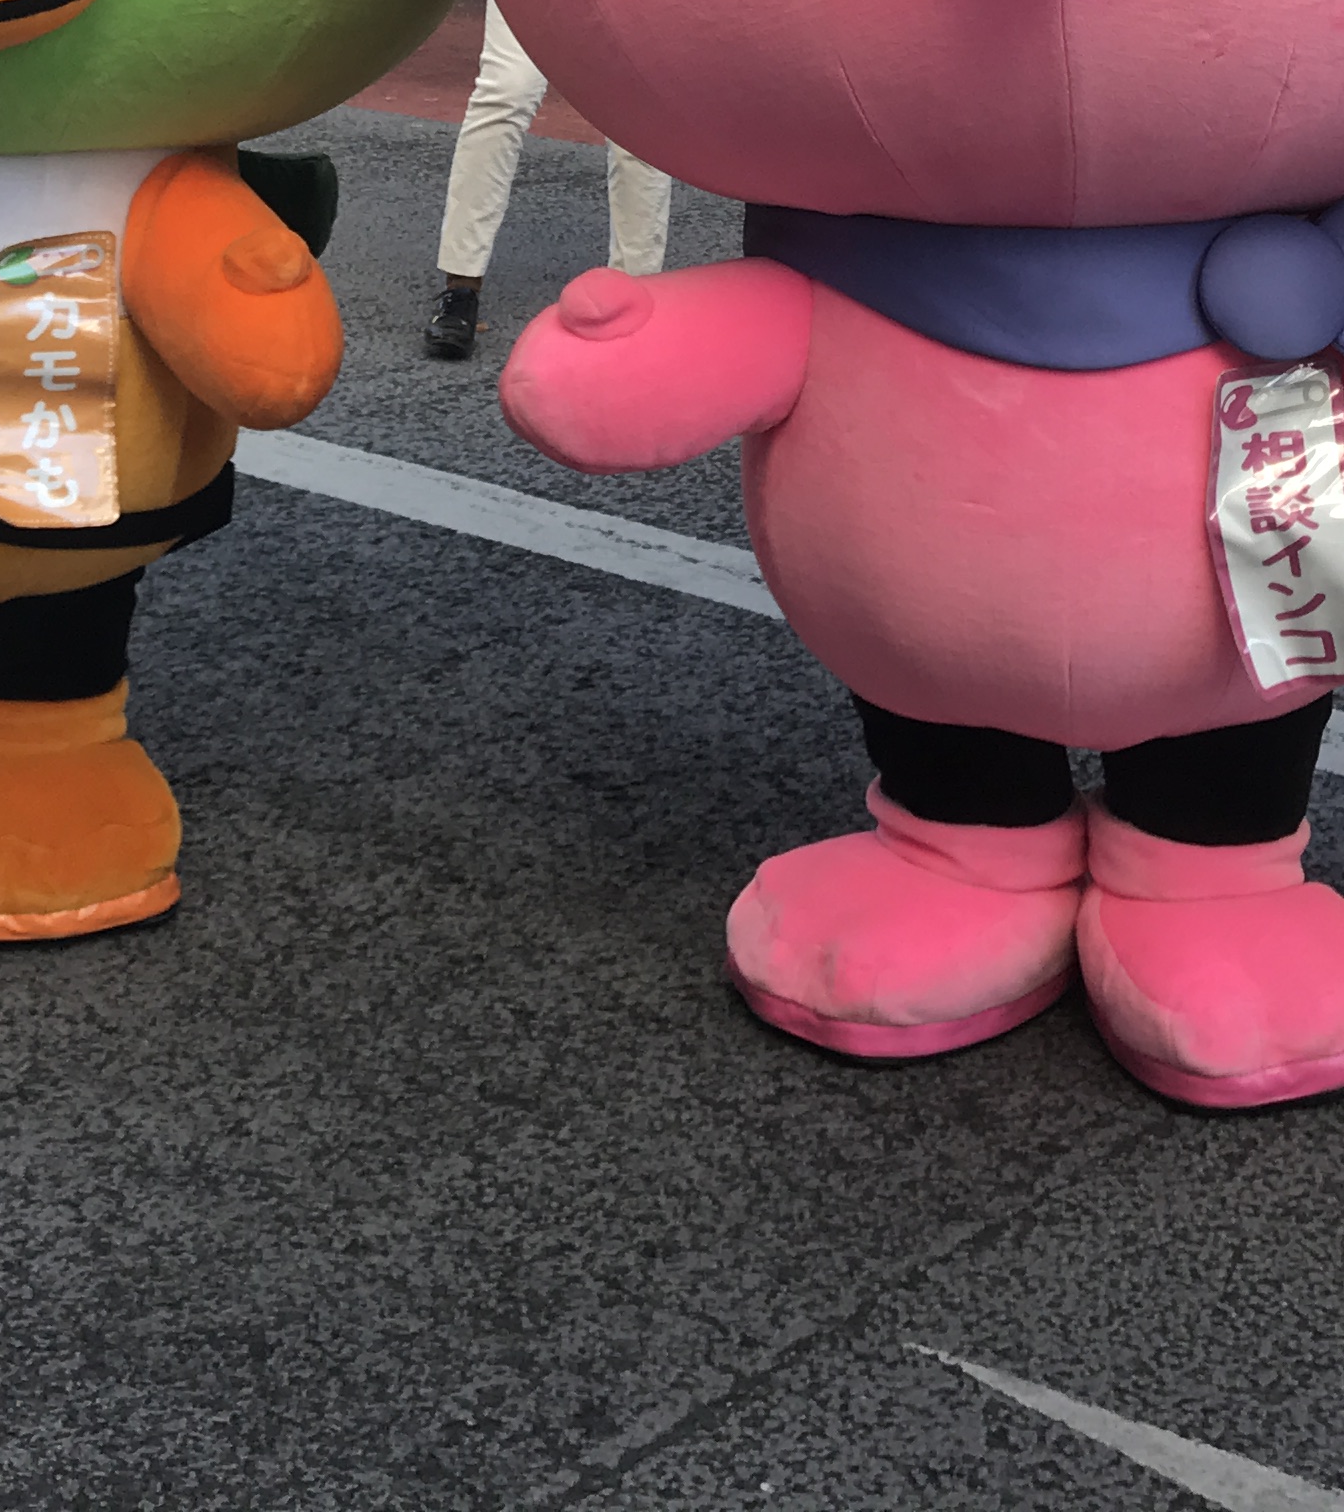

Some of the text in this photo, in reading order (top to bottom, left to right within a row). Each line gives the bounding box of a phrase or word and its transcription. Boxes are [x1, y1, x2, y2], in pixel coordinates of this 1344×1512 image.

[20, 291, 81, 509] カモかも
[1241, 429, 1337, 666] 相談インコ
